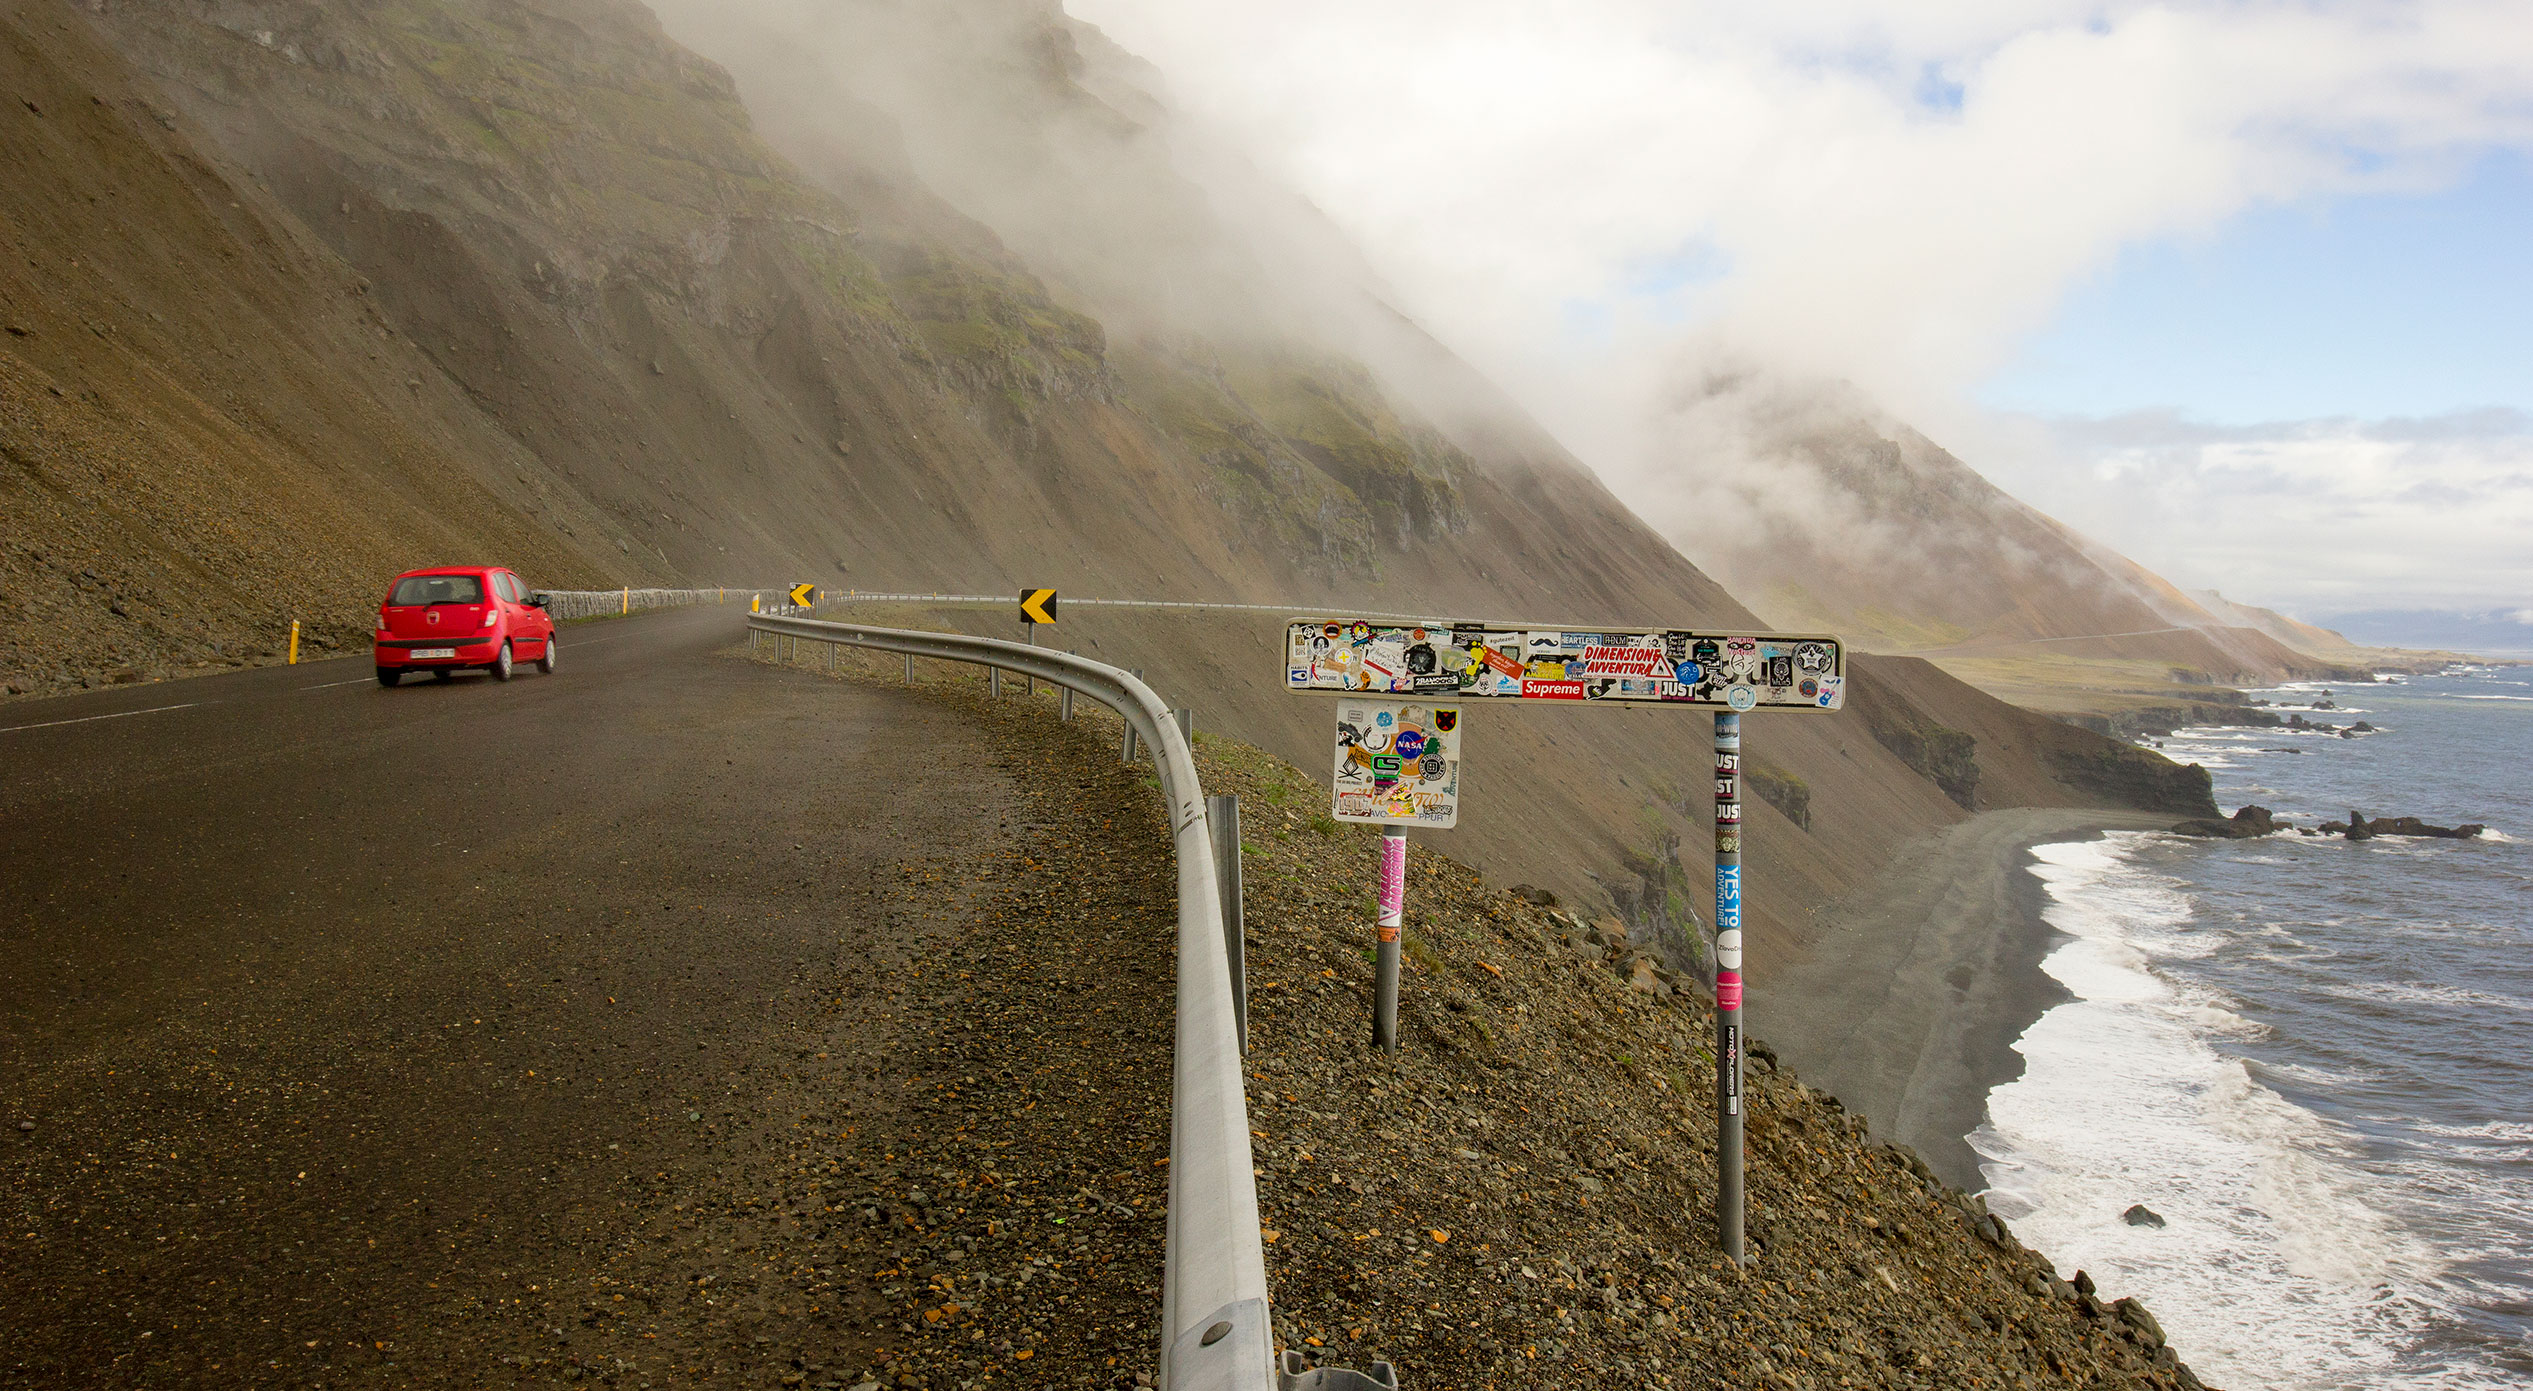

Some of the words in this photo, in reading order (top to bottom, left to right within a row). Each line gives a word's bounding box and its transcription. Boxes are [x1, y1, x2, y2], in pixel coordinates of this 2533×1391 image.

[1584, 646, 1661, 662] DIMENSIONE
[1586, 661, 1654, 676] AVVENTURA
[1525, 681, 1581, 697] Supreme
[1662, 681, 1696, 697] JUST
[1397, 740, 1423, 750] NASA
[1715, 754, 1739, 770] UST
[1715, 779, 1733, 794] ST
[1717, 804, 1741, 819] JUS
[1724, 866, 1739, 900] YES
[1717, 867, 1725, 926] ADVENTURE!
[1724, 904, 1739, 927] TO
